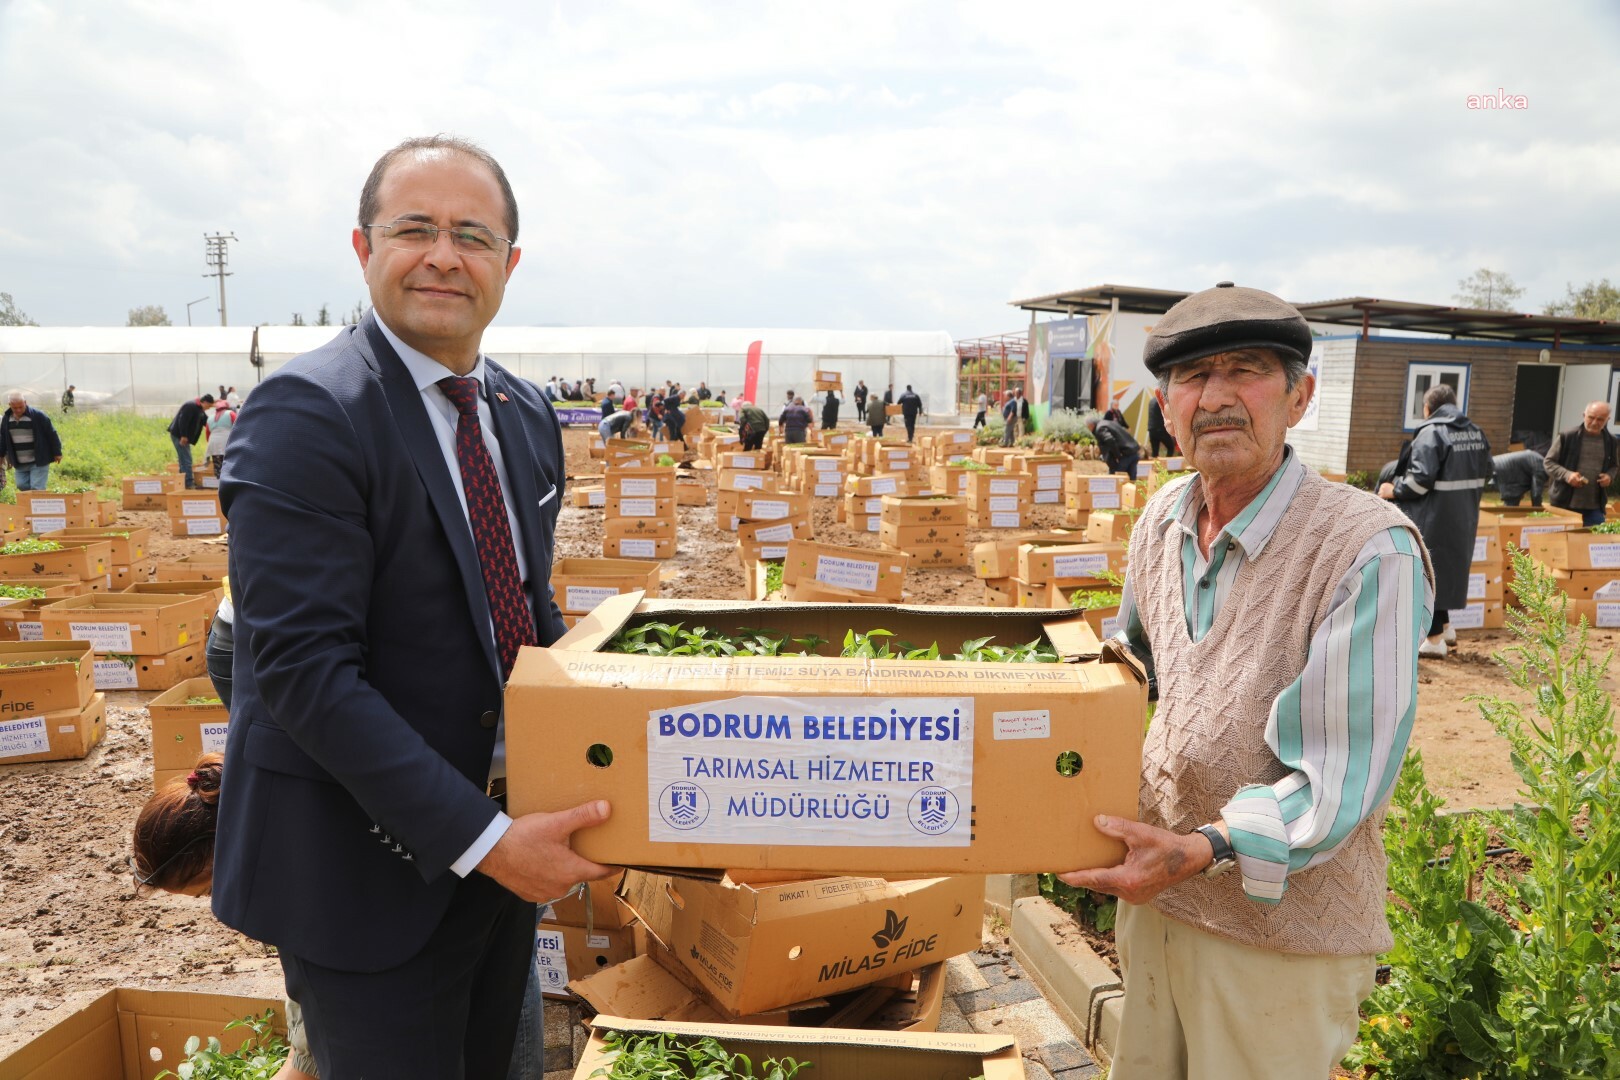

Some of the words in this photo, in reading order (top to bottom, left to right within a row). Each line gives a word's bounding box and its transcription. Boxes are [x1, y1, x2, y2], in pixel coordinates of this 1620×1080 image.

[567, 661, 625, 673] DİKKAT
[744, 665, 794, 676] TEMİZ
[798, 666, 842, 676] SUYA
[846, 668, 968, 679] BANDIRMADAN
[1, 701, 35, 713] FİDE
[0, 719, 42, 733] BELEDİYESİ
[659, 712, 792, 740] BODRUM
[803, 708, 960, 742] BELEDİYESİ
[2, 732, 37, 742] HİZMETLER
[682, 757, 799, 780] TARIMSAL
[808, 755, 934, 782] HİZMETLER
[727, 792, 890, 820] MÜDÜRLÜĞÜ
[669, 814, 700, 826] BELEDİYESİ
[917, 820, 949, 831] BELEDİYESİ
[779, 890, 805, 902] DİKKAT
[821, 882, 854, 894] FİDELERİ
[818, 950, 888, 982] MİLAS
[892, 934, 938, 964] FİDE
[699, 954, 718, 976] MİLAS
[718, 972, 733, 989] FİDE
[936, 1040, 977, 1049] DİKKAT
